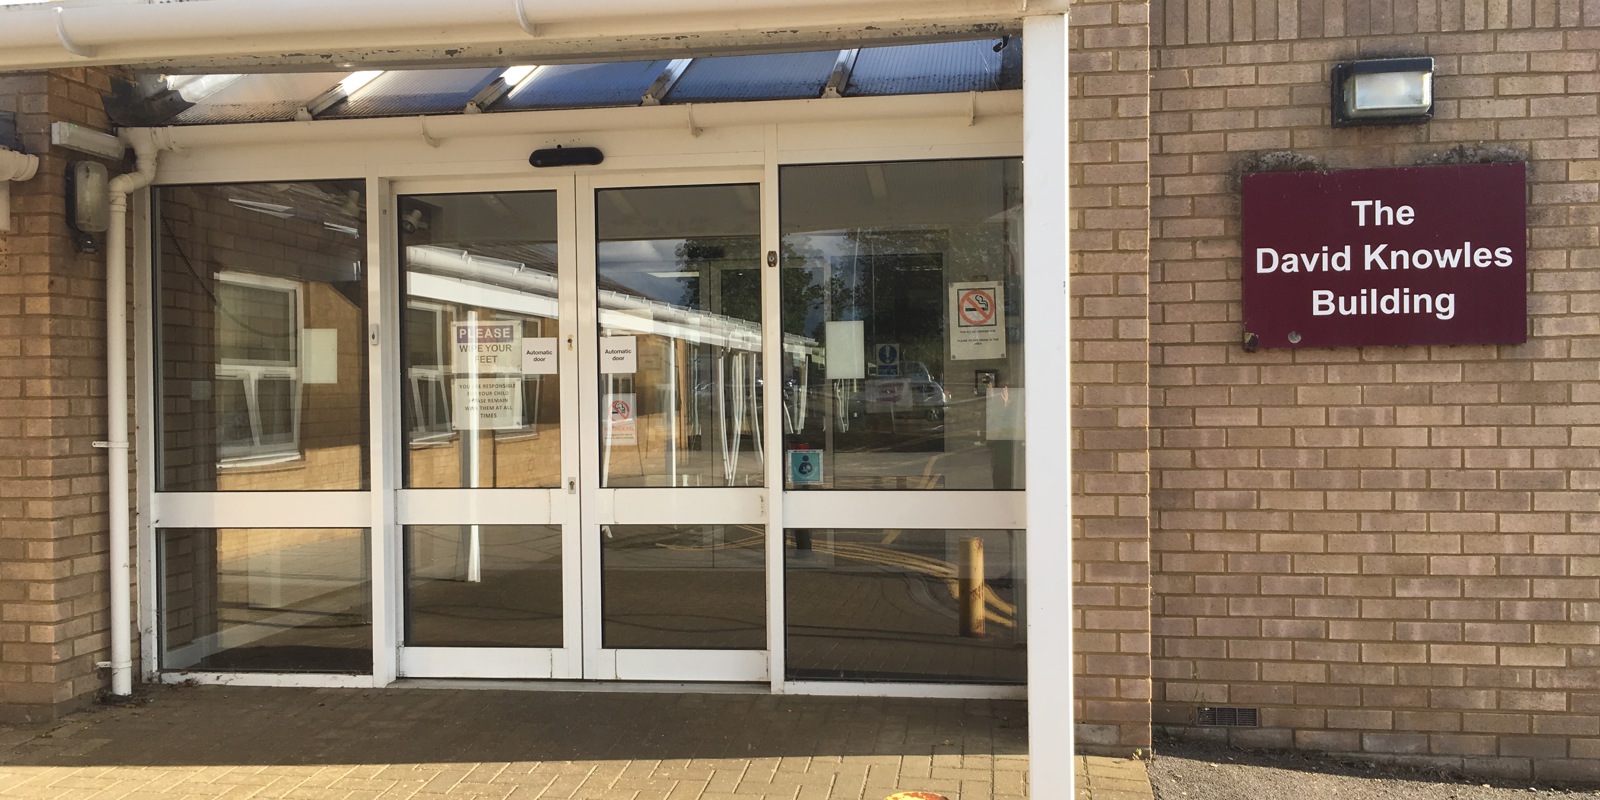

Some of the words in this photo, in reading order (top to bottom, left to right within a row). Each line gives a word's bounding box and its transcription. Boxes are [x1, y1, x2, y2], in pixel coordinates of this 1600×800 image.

[1350, 199, 1415, 227] The
[1255, 244, 1351, 274] David
[1363, 241, 1514, 271] Knowles
[1311, 287, 1456, 320] Building
[459, 327, 511, 339] PLEASE
[485, 344, 512, 352] YOUR
